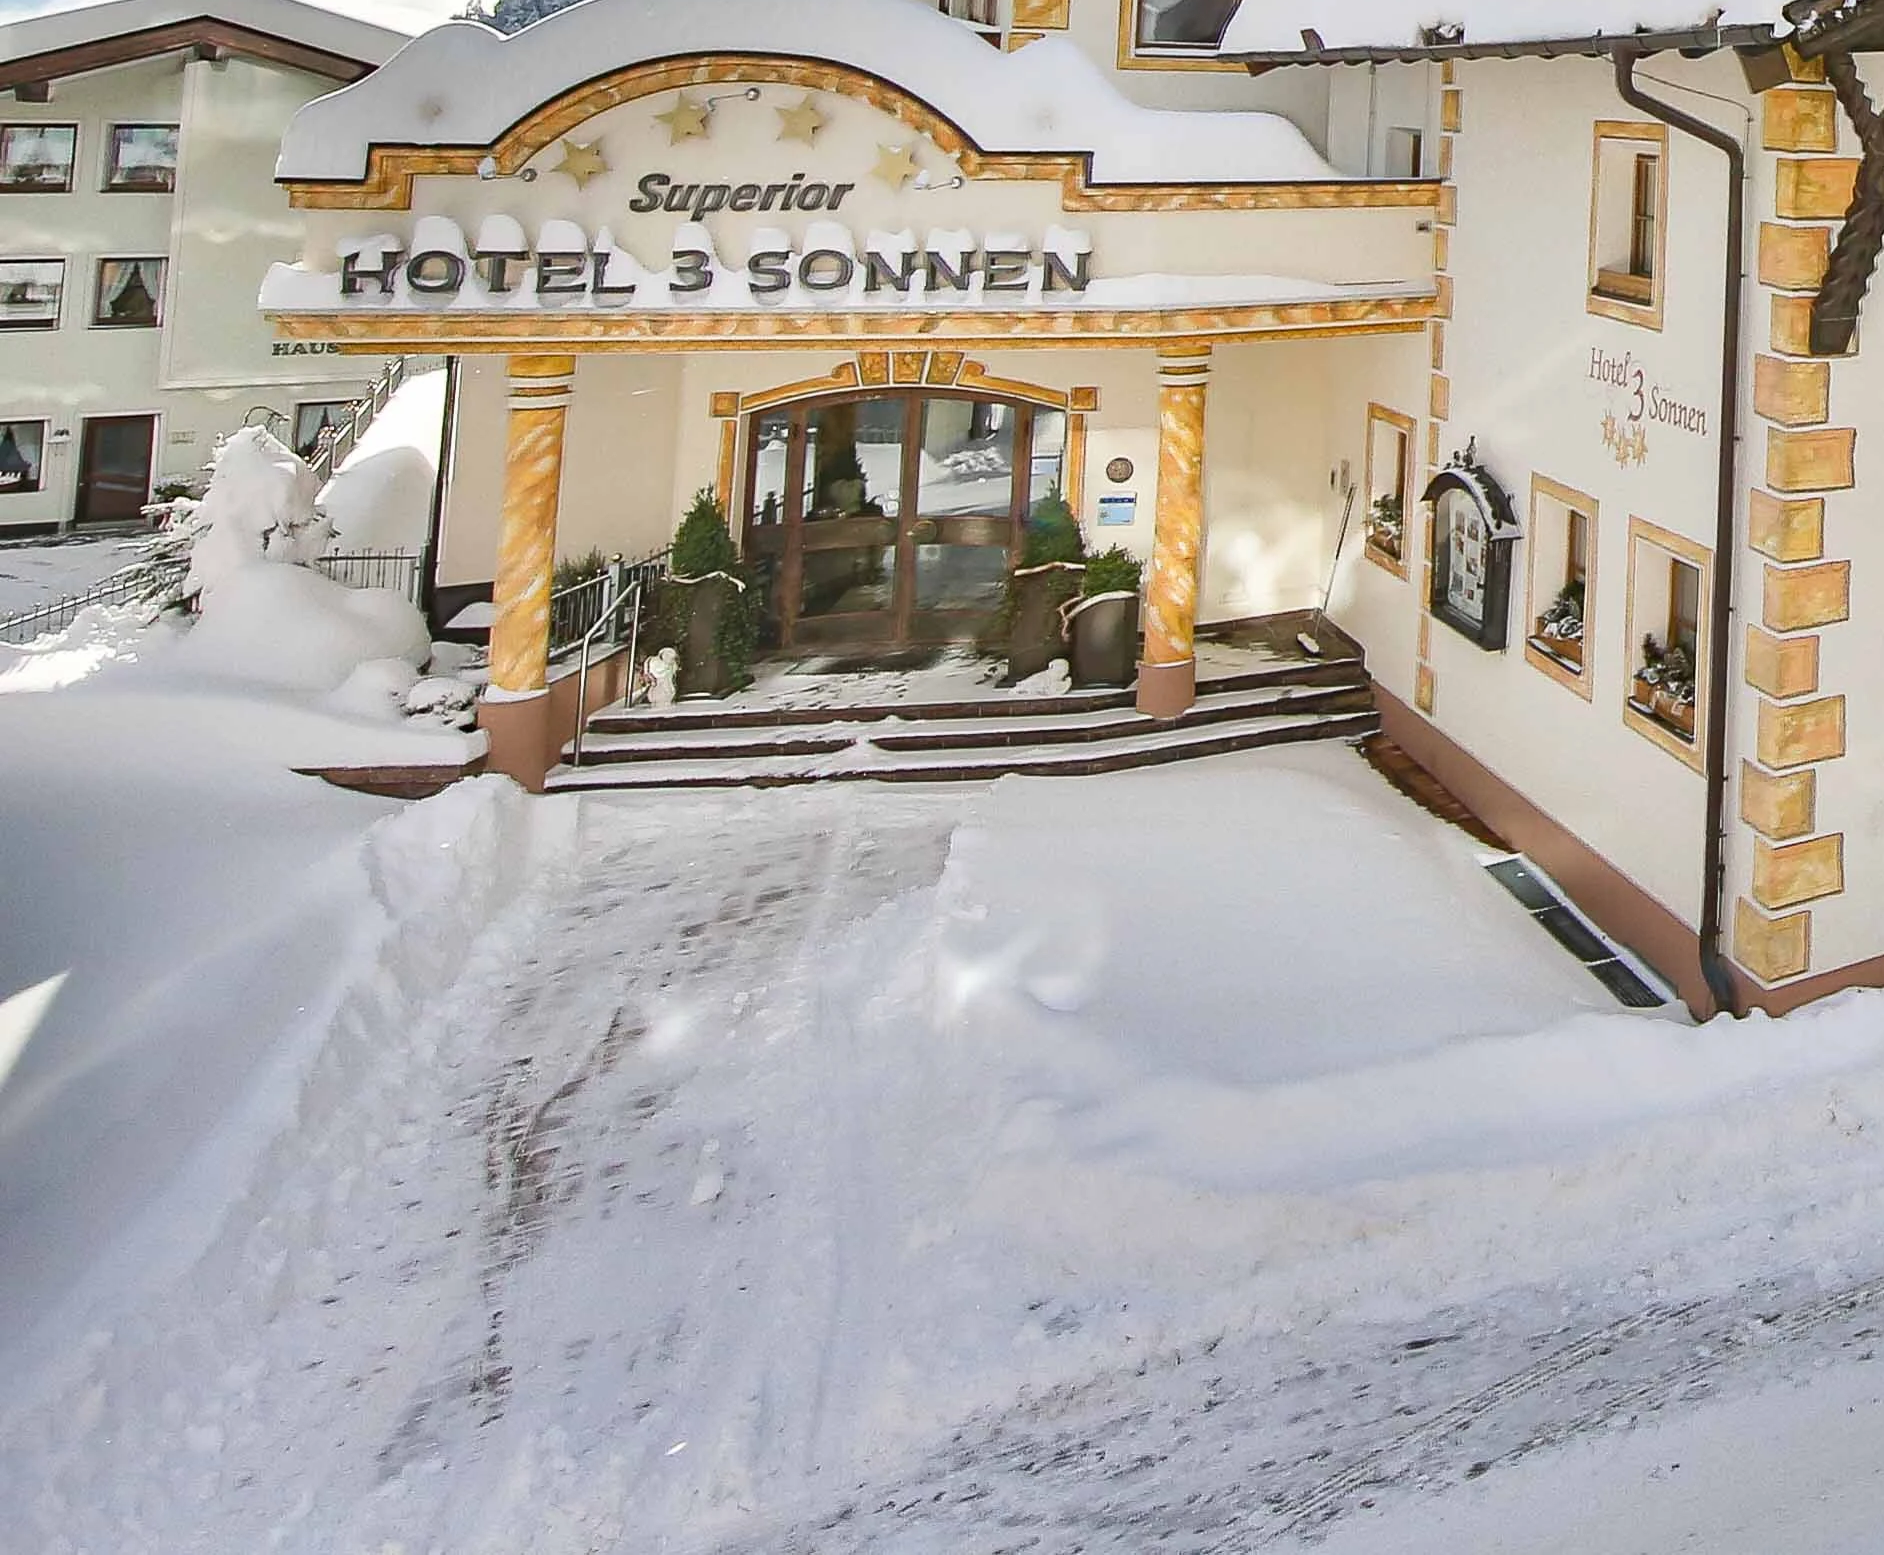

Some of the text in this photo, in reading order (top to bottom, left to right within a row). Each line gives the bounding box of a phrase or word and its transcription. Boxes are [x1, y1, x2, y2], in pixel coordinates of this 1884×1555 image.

[629, 173, 855, 222] Superior
[339, 248, 1093, 295] HOTEL 3 SONNEN
[1589, 347, 1708, 436] Hotel 3 Sonnen
